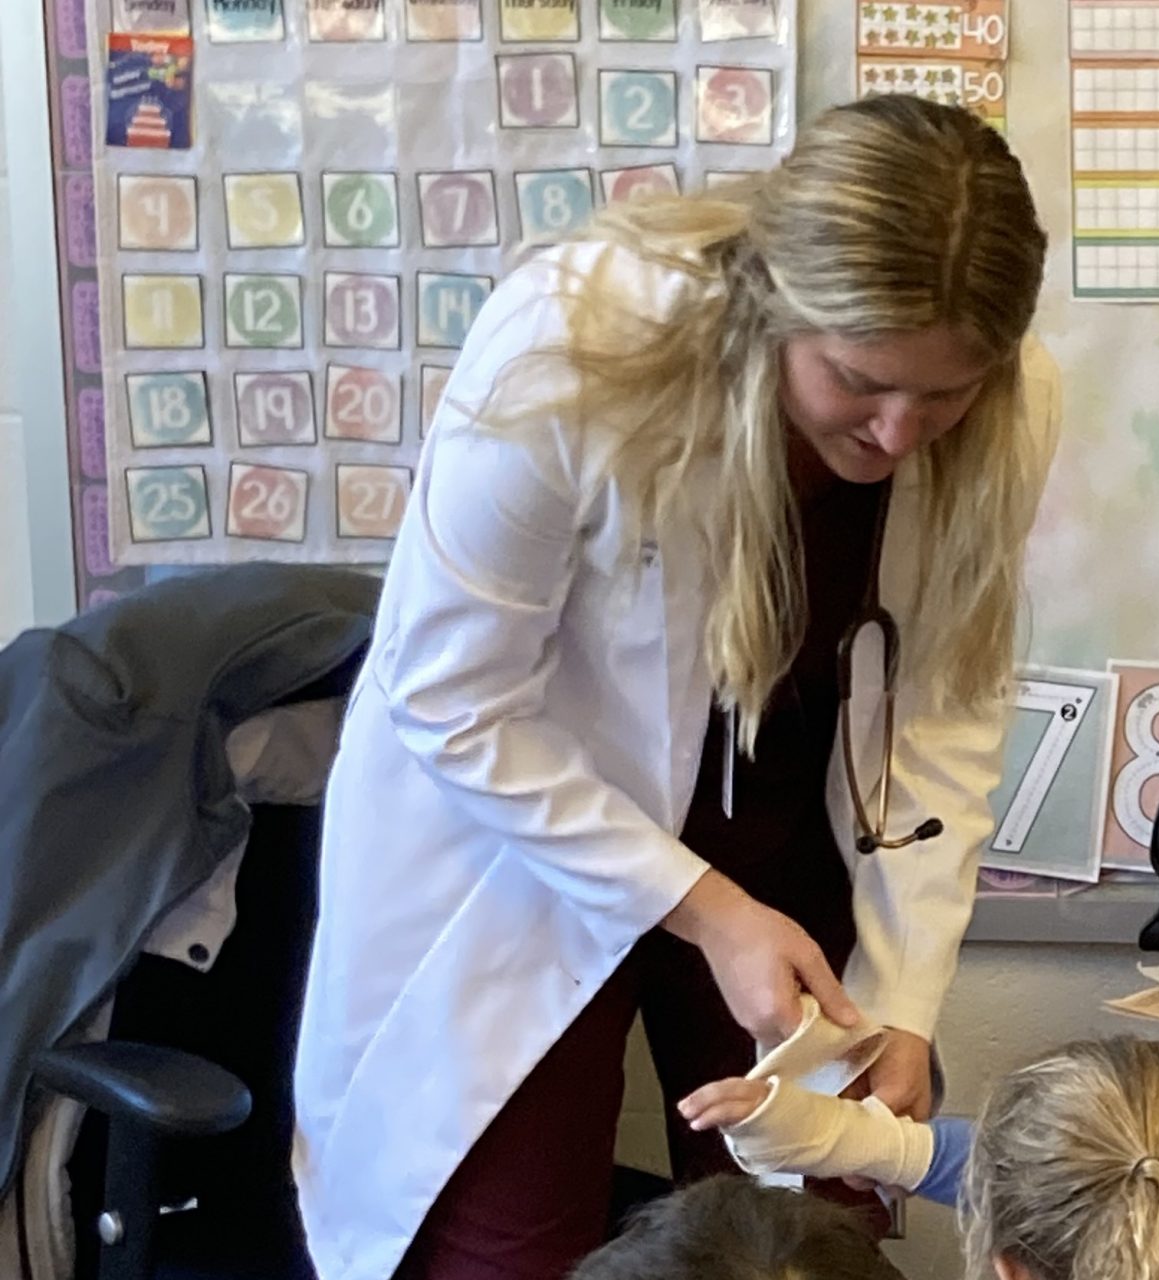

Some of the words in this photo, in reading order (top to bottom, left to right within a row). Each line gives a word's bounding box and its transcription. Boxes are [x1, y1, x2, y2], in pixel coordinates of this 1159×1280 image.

[962, 14, 1004, 45] 40
[623, 85, 654, 131] 2
[963, 71, 1004, 102] 50
[141, 191, 169, 237] 4
[251, 187, 279, 232] 5
[348, 188, 373, 231] 6
[443, 187, 469, 233] 7
[543, 183, 572, 228] 8
[152, 288, 174, 332] 11
[241, 289, 283, 333] 12
[344, 289, 379, 333] 13
[439, 287, 473, 330] 14
[150, 385, 192, 431] 18
[254, 386, 296, 431] 19
[337, 384, 391, 430] 20
[143, 481, 196, 523] 25
[241, 479, 292, 522] 26
[351, 481, 397, 522] 27
[1062, 704, 1076, 721] 2
[990, 679, 1098, 854] 7
